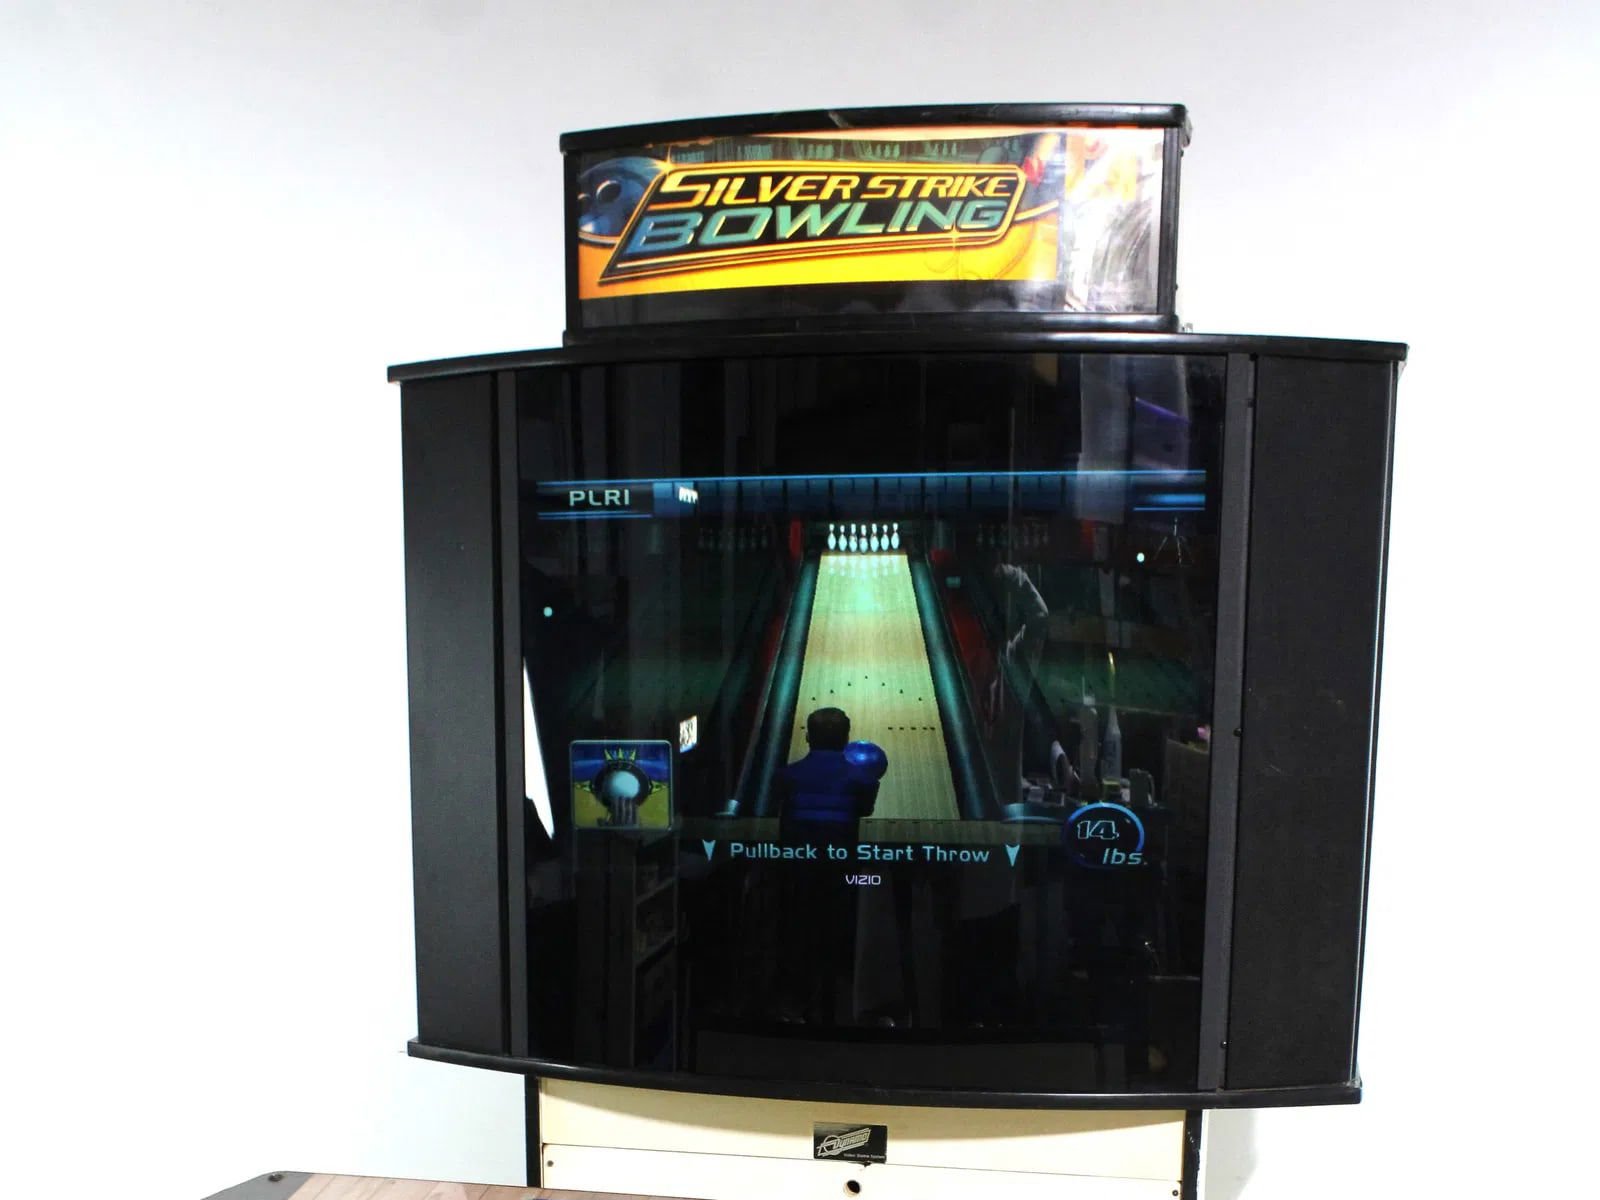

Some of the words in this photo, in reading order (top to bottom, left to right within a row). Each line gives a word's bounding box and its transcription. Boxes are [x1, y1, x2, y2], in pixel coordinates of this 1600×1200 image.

[649, 170, 856, 210] SILVER
[860, 173, 1017, 199] STRIKE
[626, 199, 1008, 253] BOWLING
[729, 842, 817, 859] Pullback
[827, 843, 849, 860] to
[856, 845, 914, 862] Start
[922, 845, 990, 863] Throw
[845, 874, 882, 886] VIZIO
